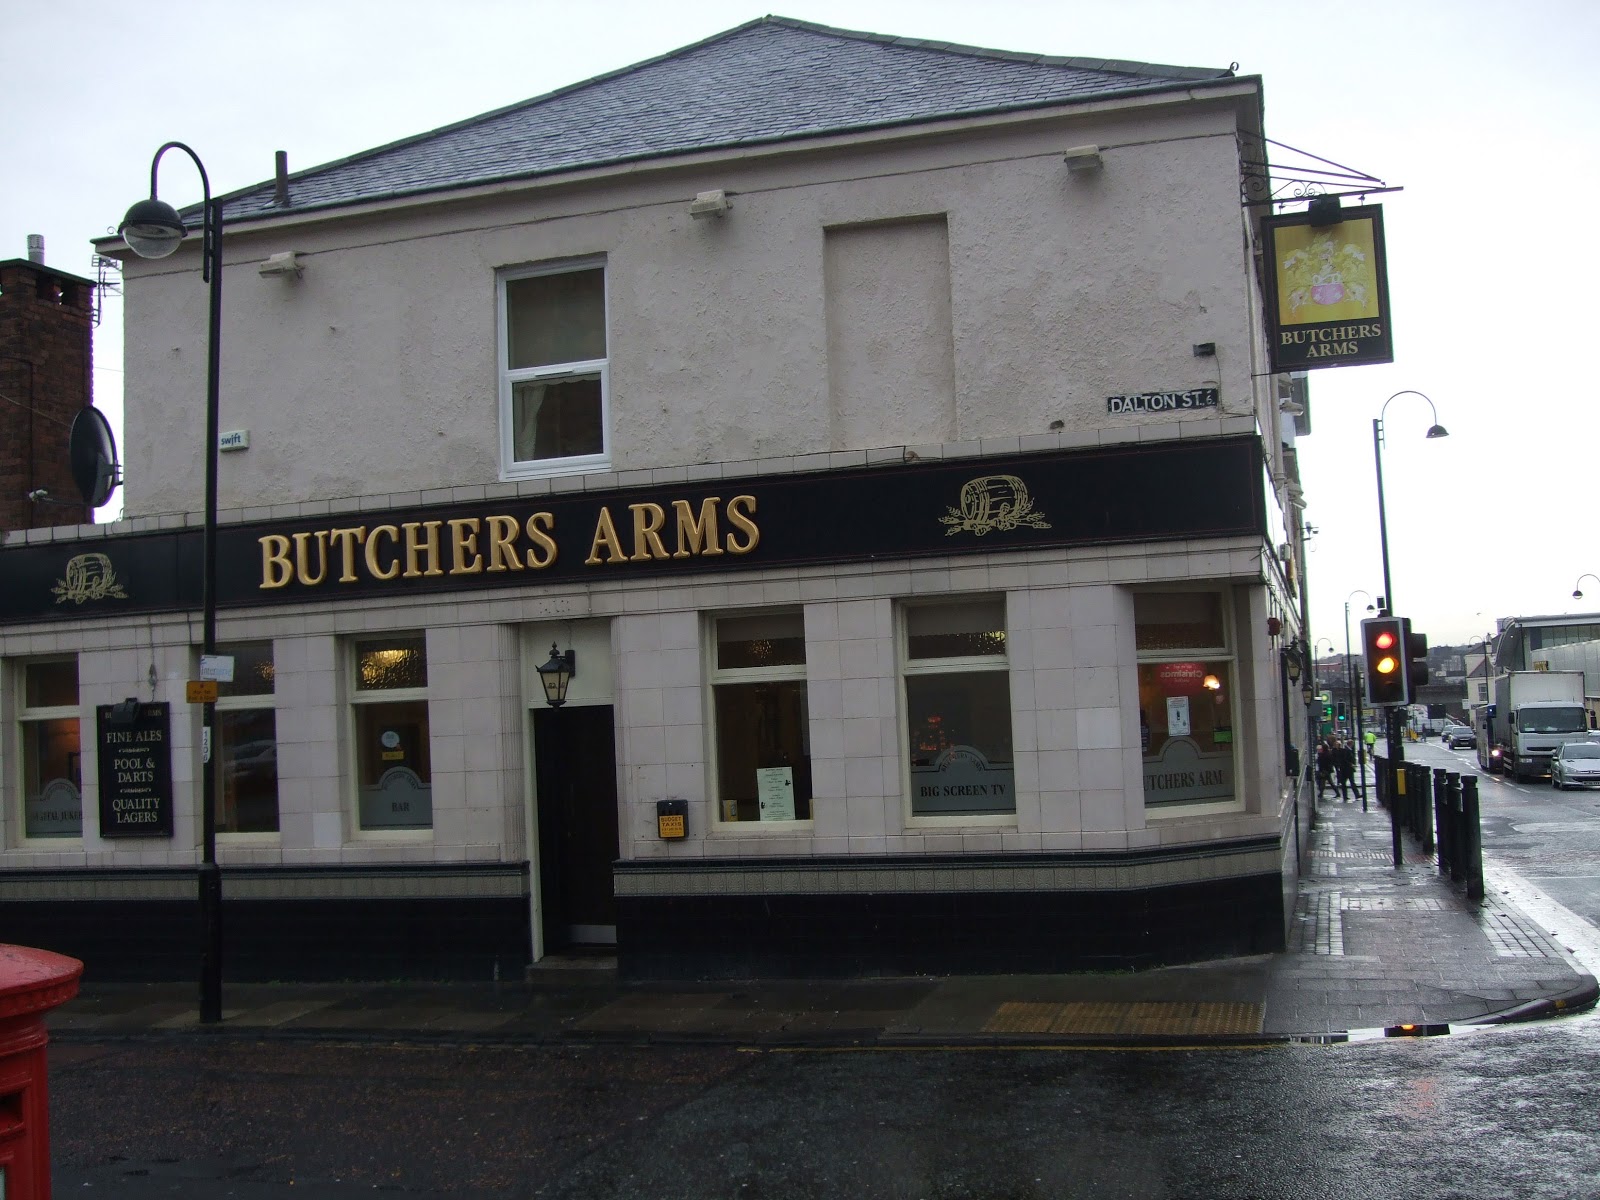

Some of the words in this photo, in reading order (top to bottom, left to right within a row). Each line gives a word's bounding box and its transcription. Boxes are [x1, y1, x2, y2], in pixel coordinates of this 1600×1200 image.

[1280, 323, 1382, 346] BUTCHERS
[1306, 341, 1359, 358] ARMS
[1110, 394, 1176, 413] DALTON
[221, 432, 241, 446] swift
[258, 511, 558, 590] BUTCHERS
[584, 494, 760, 566] ARMS
[106, 732, 132, 743] FINE
[135, 730, 162, 742] ALES
[114, 758, 143, 770] POOL
[146, 757, 155, 769] &
[118, 771, 154, 783] DARTS
[1143, 771, 1195, 791] UTCHERS
[920, 785, 939, 797] BIG
[943, 784, 987, 797] SCREEN
[991, 784, 1006, 795] TV
[112, 797, 160, 811] QUALITY
[392, 802, 409, 812] BAR
[116, 811, 158, 823] LAGERS
